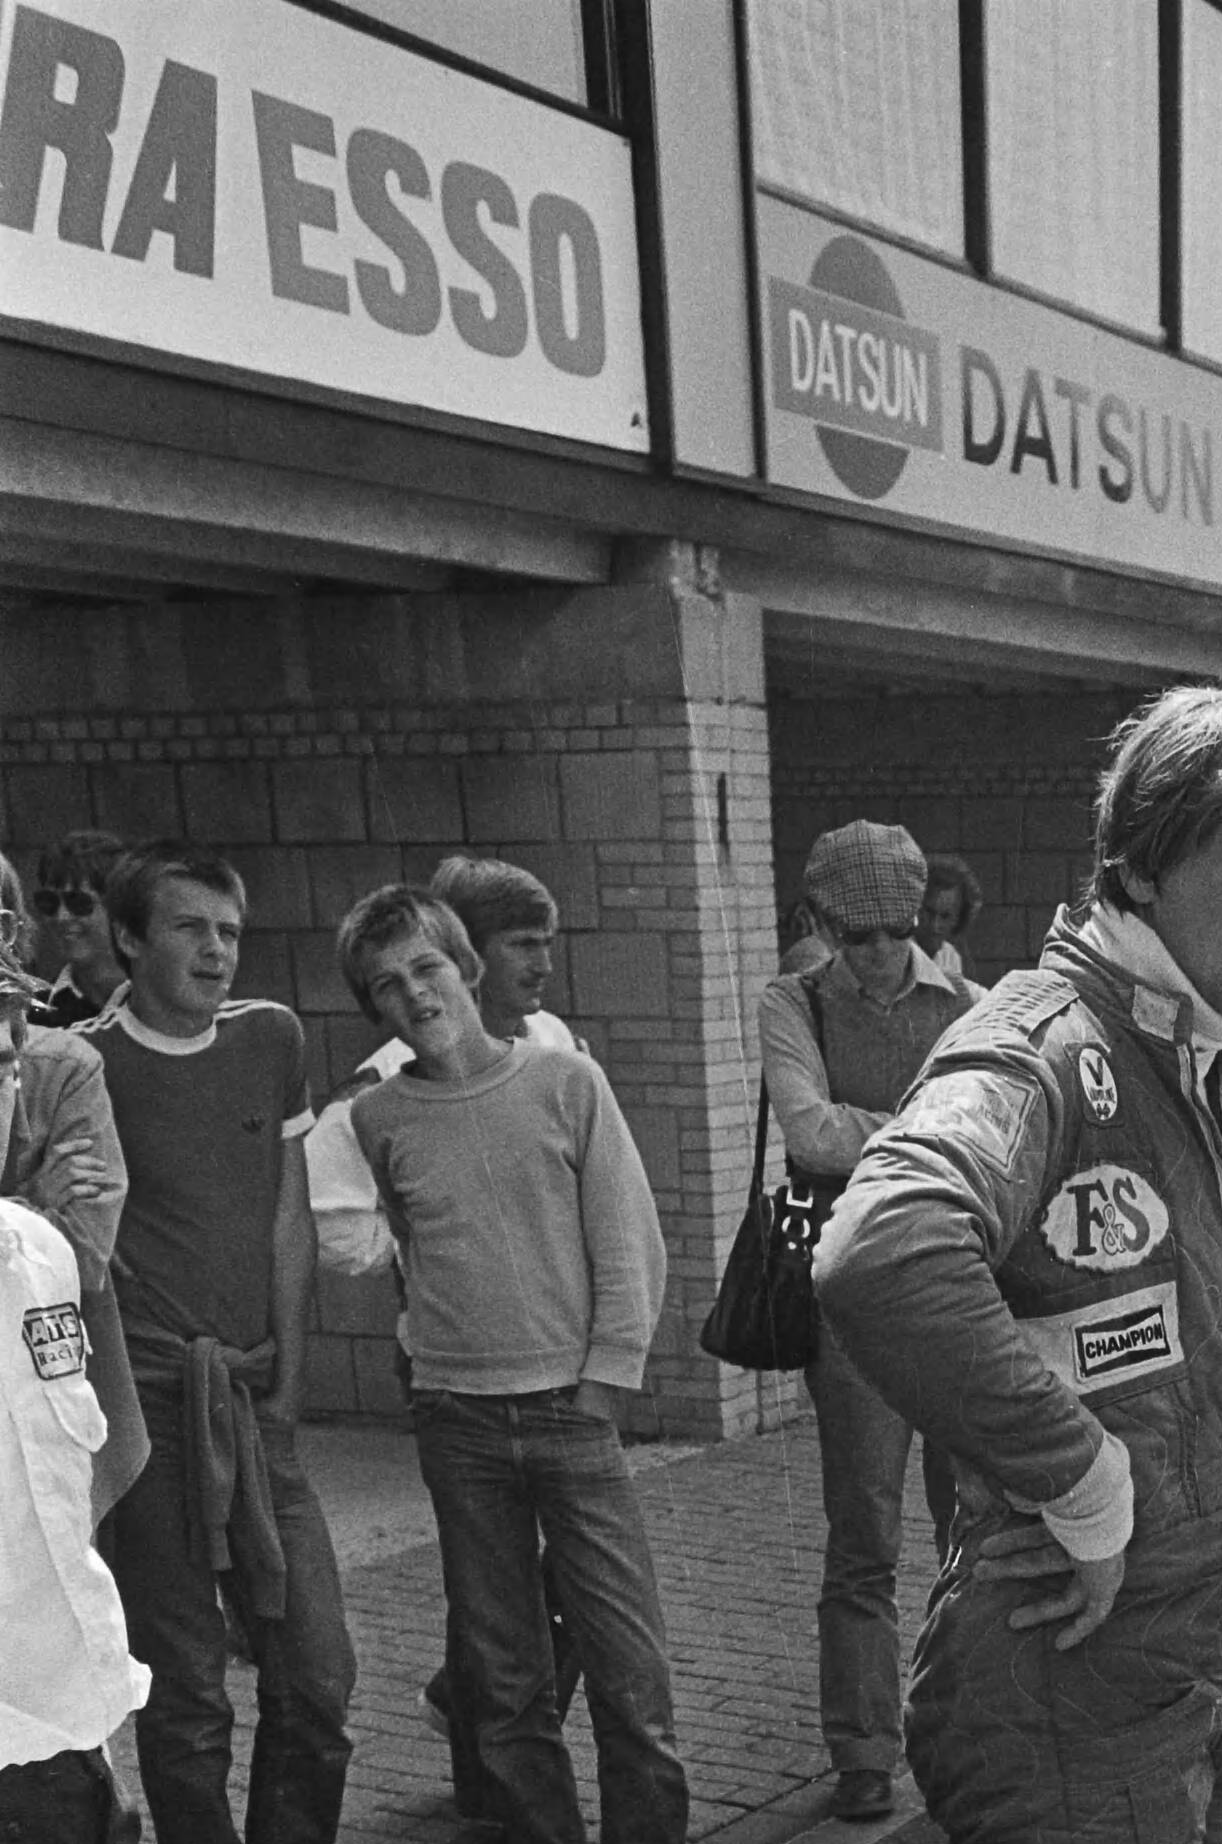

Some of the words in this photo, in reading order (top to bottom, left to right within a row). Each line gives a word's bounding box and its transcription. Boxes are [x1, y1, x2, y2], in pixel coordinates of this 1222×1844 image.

[0, 4, 217, 279] RA
[251, 89, 606, 378] ESSO
[788, 308, 928, 428] DATSUN
[958, 344, 1214, 527] DATSUN
[1067, 1176, 1151, 1258] F&S
[30, 1311, 79, 1346] ATS
[37, 1343, 80, 1366] Raci
[1084, 1320, 1164, 1360] CHAMPION
